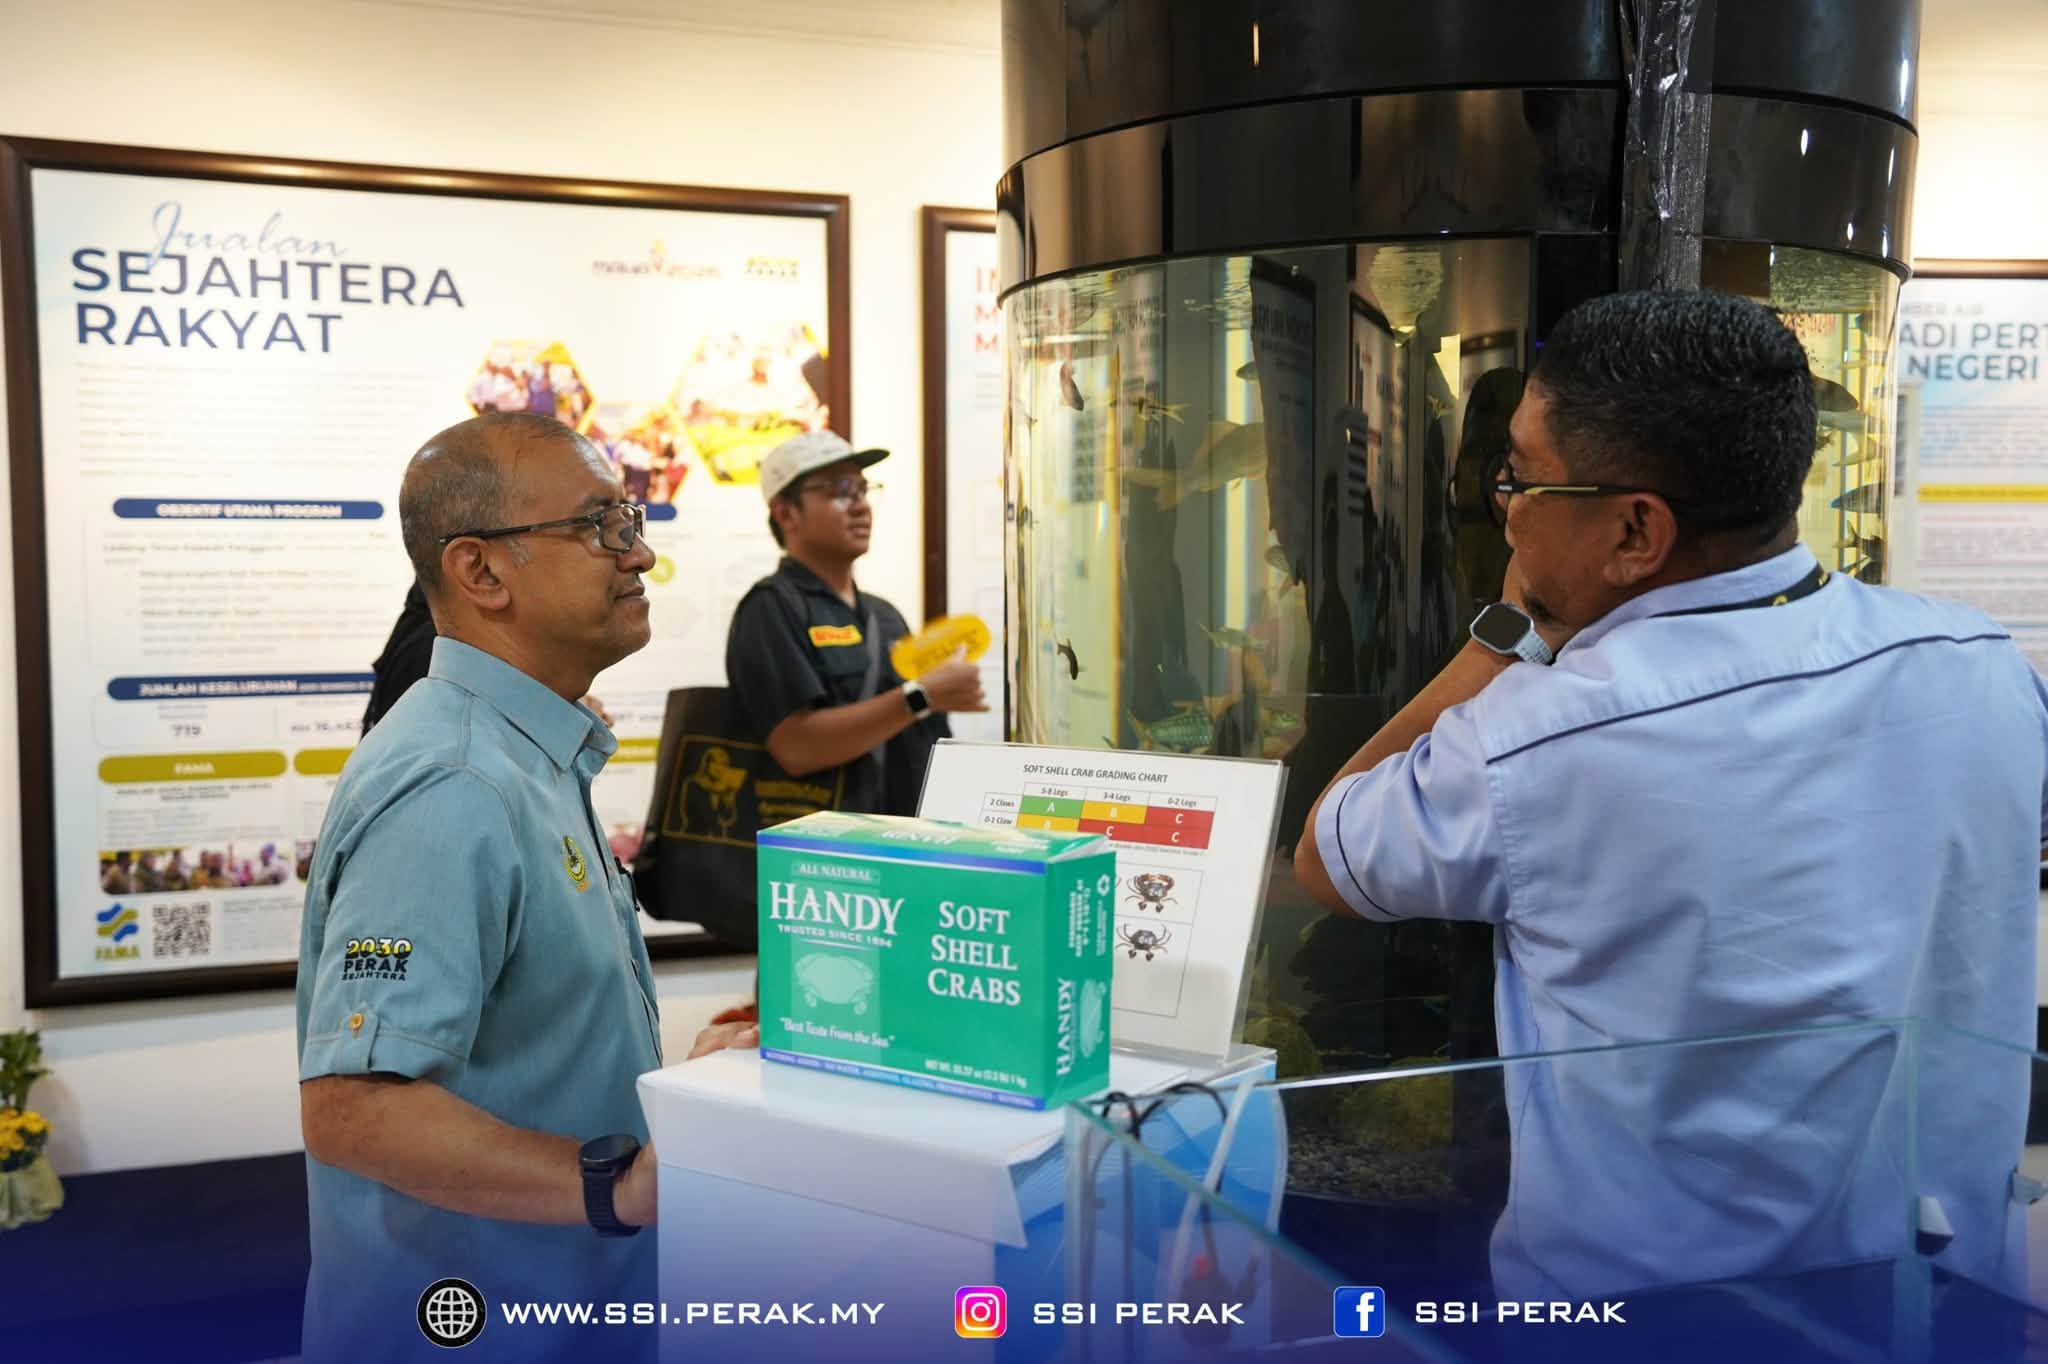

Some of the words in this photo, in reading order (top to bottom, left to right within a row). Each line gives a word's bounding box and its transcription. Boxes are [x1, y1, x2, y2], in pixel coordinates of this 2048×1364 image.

[145, 200, 348, 273] Jualan
[72, 248, 464, 308] SEJAHTERA
[76, 302, 343, 353] RAKYAT
[1908, 354, 2038, 381] NEGERI
[139, 682, 197, 697] JUMLAH
[1023, 764, 1045, 775] SOFT
[1045, 765, 1069, 777] SHELL
[1071, 768, 1094, 778] CRAB
[1095, 769, 1136, 781] GRADING
[1138, 772, 1169, 784] CHART
[1053, 788, 1069, 797] Legs
[1115, 793, 1131, 802] Legs
[1047, 802, 1056, 813] A
[996, 816, 1013, 825] Claw
[1175, 813, 1184, 824] C
[1106, 825, 1115, 837] C
[1171, 831, 1181, 843] C
[799, 863, 818, 875] ALL
[821, 866, 872, 881] NATURAL
[769, 880, 905, 936] HANDY
[937, 901, 1010, 935] SOFT
[777, 924, 826, 937] TRUSTED
[828, 929, 863, 943] SINCE
[344, 936, 413, 958] 2030
[930, 935, 1018, 971] SHELL
[343, 958, 408, 973] PERAK
[342, 970, 406, 981] SEJAHTERA
[928, 968, 1021, 1006] CRABS
[1056, 977, 1073, 1077] HANDY
